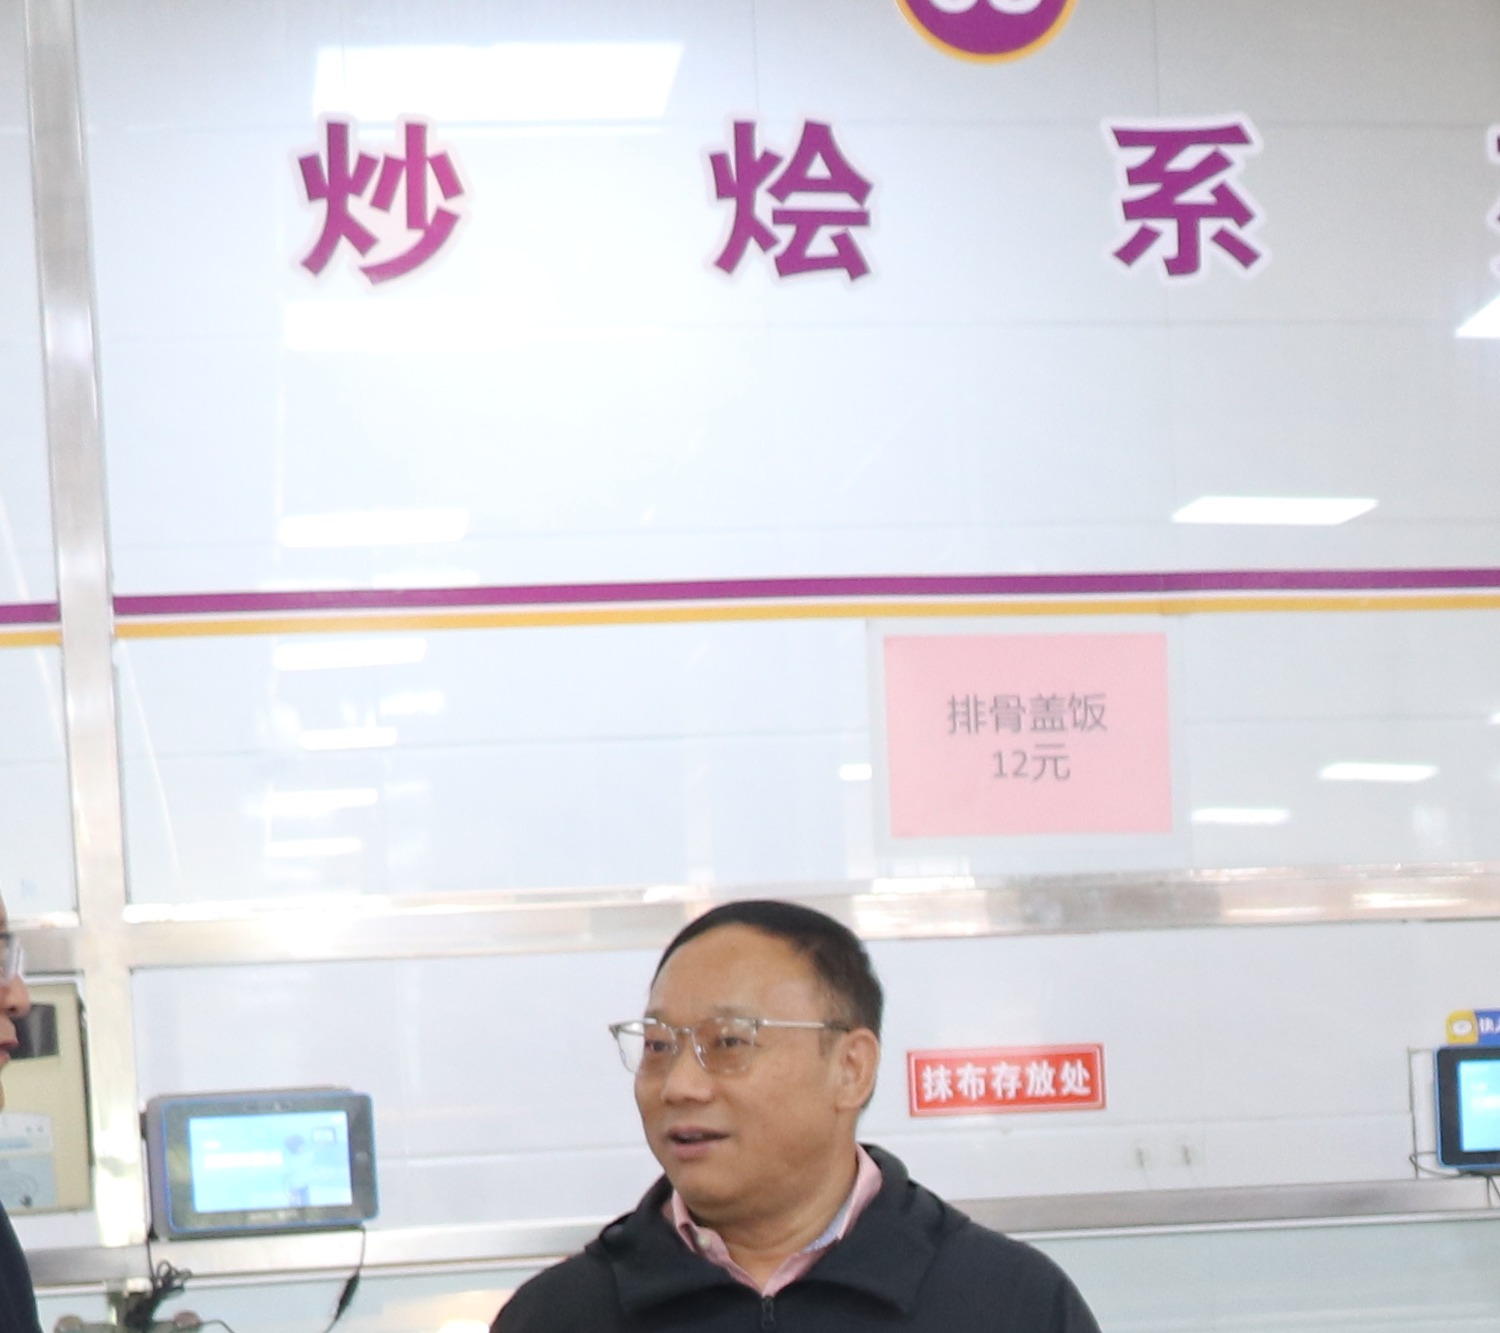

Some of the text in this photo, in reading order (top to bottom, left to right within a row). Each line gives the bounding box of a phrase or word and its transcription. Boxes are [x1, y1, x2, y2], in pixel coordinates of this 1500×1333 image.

[947, 691, 1108, 736] 排骨盖饭
[992, 743, 1072, 782] 12元
[921, 1059, 1092, 1103] 抹布存放处
